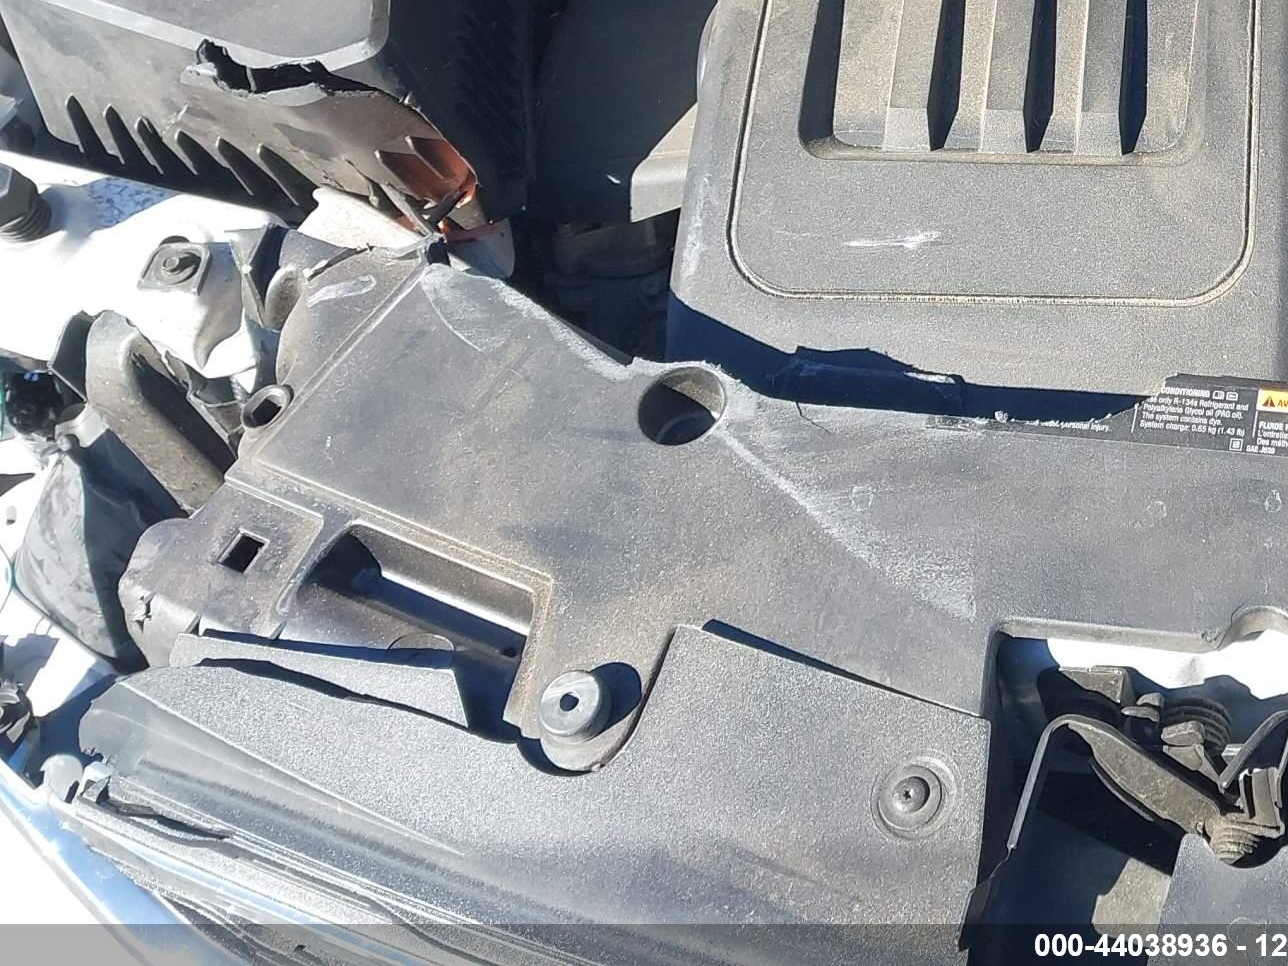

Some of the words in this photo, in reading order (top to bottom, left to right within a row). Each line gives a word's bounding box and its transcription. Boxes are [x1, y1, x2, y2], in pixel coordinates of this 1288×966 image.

[1160, 386, 1210, 398] CONDITIONING
[1143, 404, 1182, 414] Polyalkylene
[1184, 407, 1204, 416] Glycol
[1158, 397, 1172, 406] only
[1174, 397, 1198, 406] R-134a
[1200, 400, 1235, 410] Refrigerant
[1236, 404, 1249, 412] and
[1142, 411, 1154, 419] The
[1156, 414, 1178, 422] system
[1180, 416, 1208, 424] contains
[1140, 420, 1164, 428] System
[1208, 426, 1216, 435] kg
[1259, 420, 1283, 430] FLUIDE
[1256, 438, 1269, 446] Des
